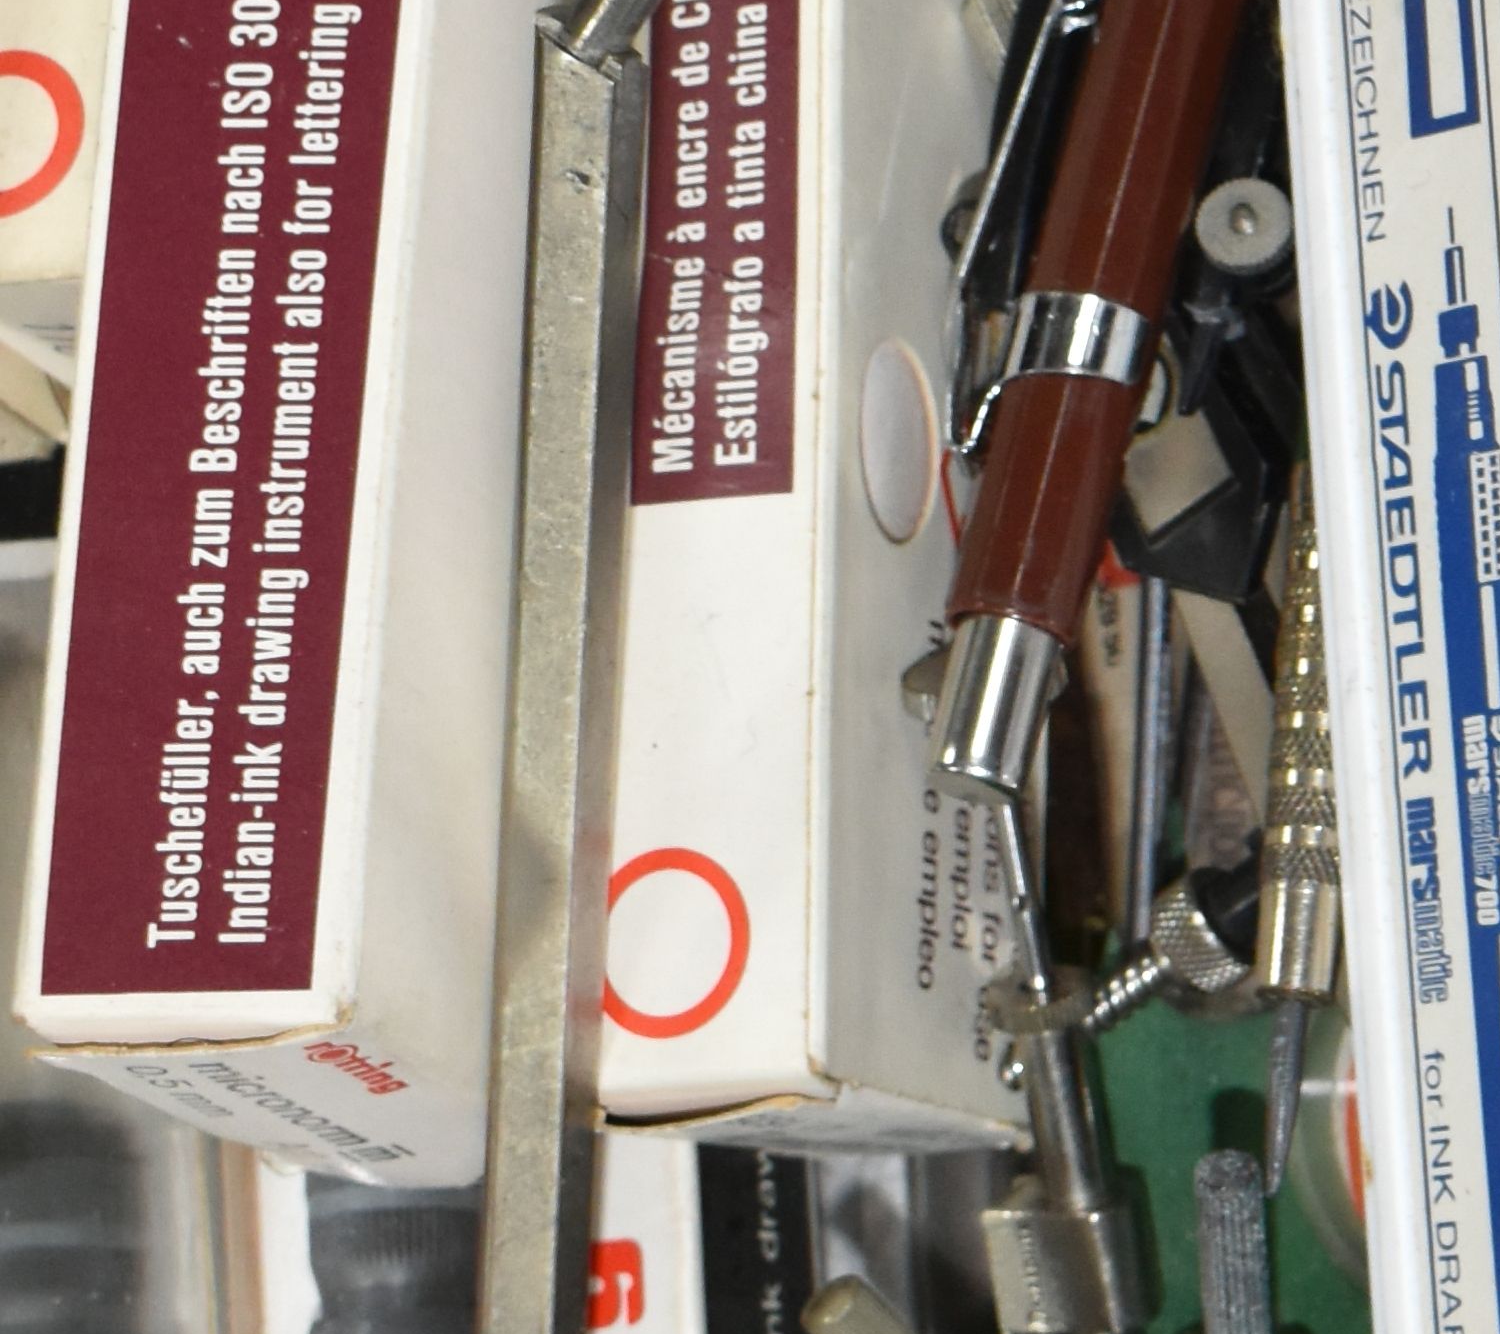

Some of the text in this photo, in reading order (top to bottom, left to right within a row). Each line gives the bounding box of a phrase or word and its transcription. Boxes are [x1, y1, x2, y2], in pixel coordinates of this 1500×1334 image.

[219, 61, 273, 129] ISO
[288, 2, 362, 165] lettering
[670, 40, 710, 87] de
[726, 2, 768, 107] china
[216, 143, 266, 233] nach
[675, 99, 709, 209] encre
[724, 119, 766, 208] tinta
[280, 178, 333, 235] for
[665, 220, 706, 243] à
[732, 220, 765, 243] a
[274, 248, 328, 328] also
[188, 248, 256, 472] Beschriften
[650, 256, 706, 473] Mécanisme
[713, 255, 769, 466] Estilógrafo
[250, 341, 319, 553] instrument
[189, 487, 234, 568] zum
[1374, 361, 1434, 778] STAEDTLER
[175, 582, 226, 675] auch
[236, 567, 309, 726] drawing
[145, 690, 220, 949] Tuschefüller,
[216, 741, 282, 943] Indian-ink
[1424, 1050, 1443, 1109] for
[1429, 1123, 1456, 1202] INK
